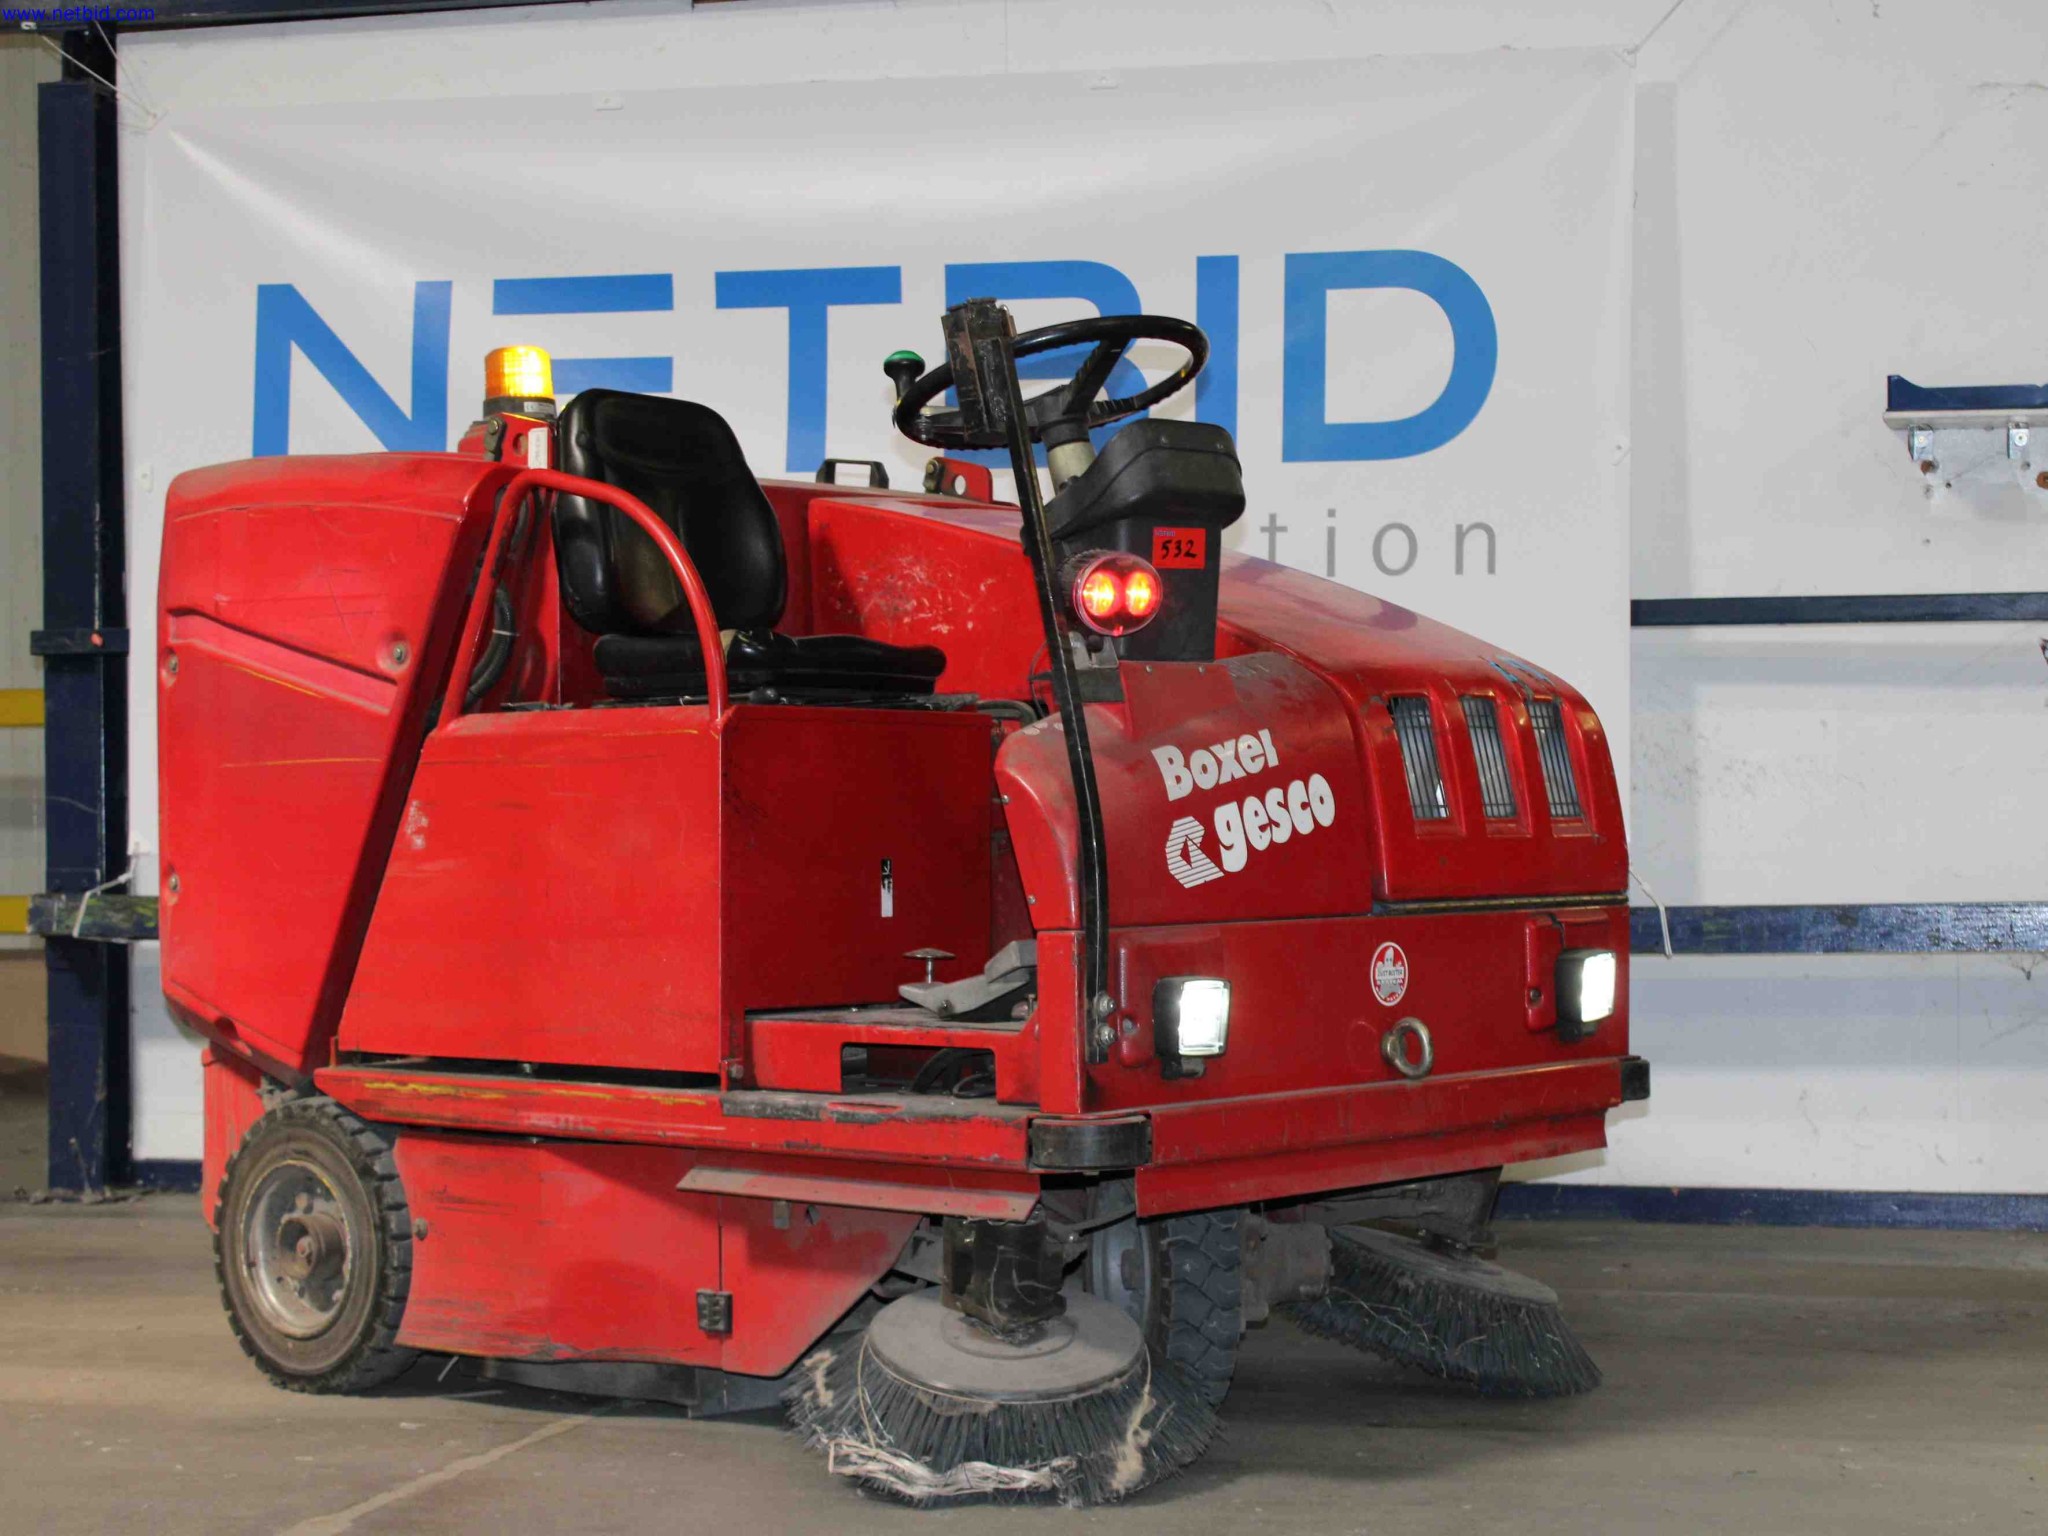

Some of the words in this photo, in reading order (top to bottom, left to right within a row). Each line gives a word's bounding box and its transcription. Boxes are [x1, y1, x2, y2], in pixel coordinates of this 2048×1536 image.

[252, 248, 1498, 473] NETBID
[1160, 539, 1198, 560] 532
[1213, 773, 1336, 873] gesco
